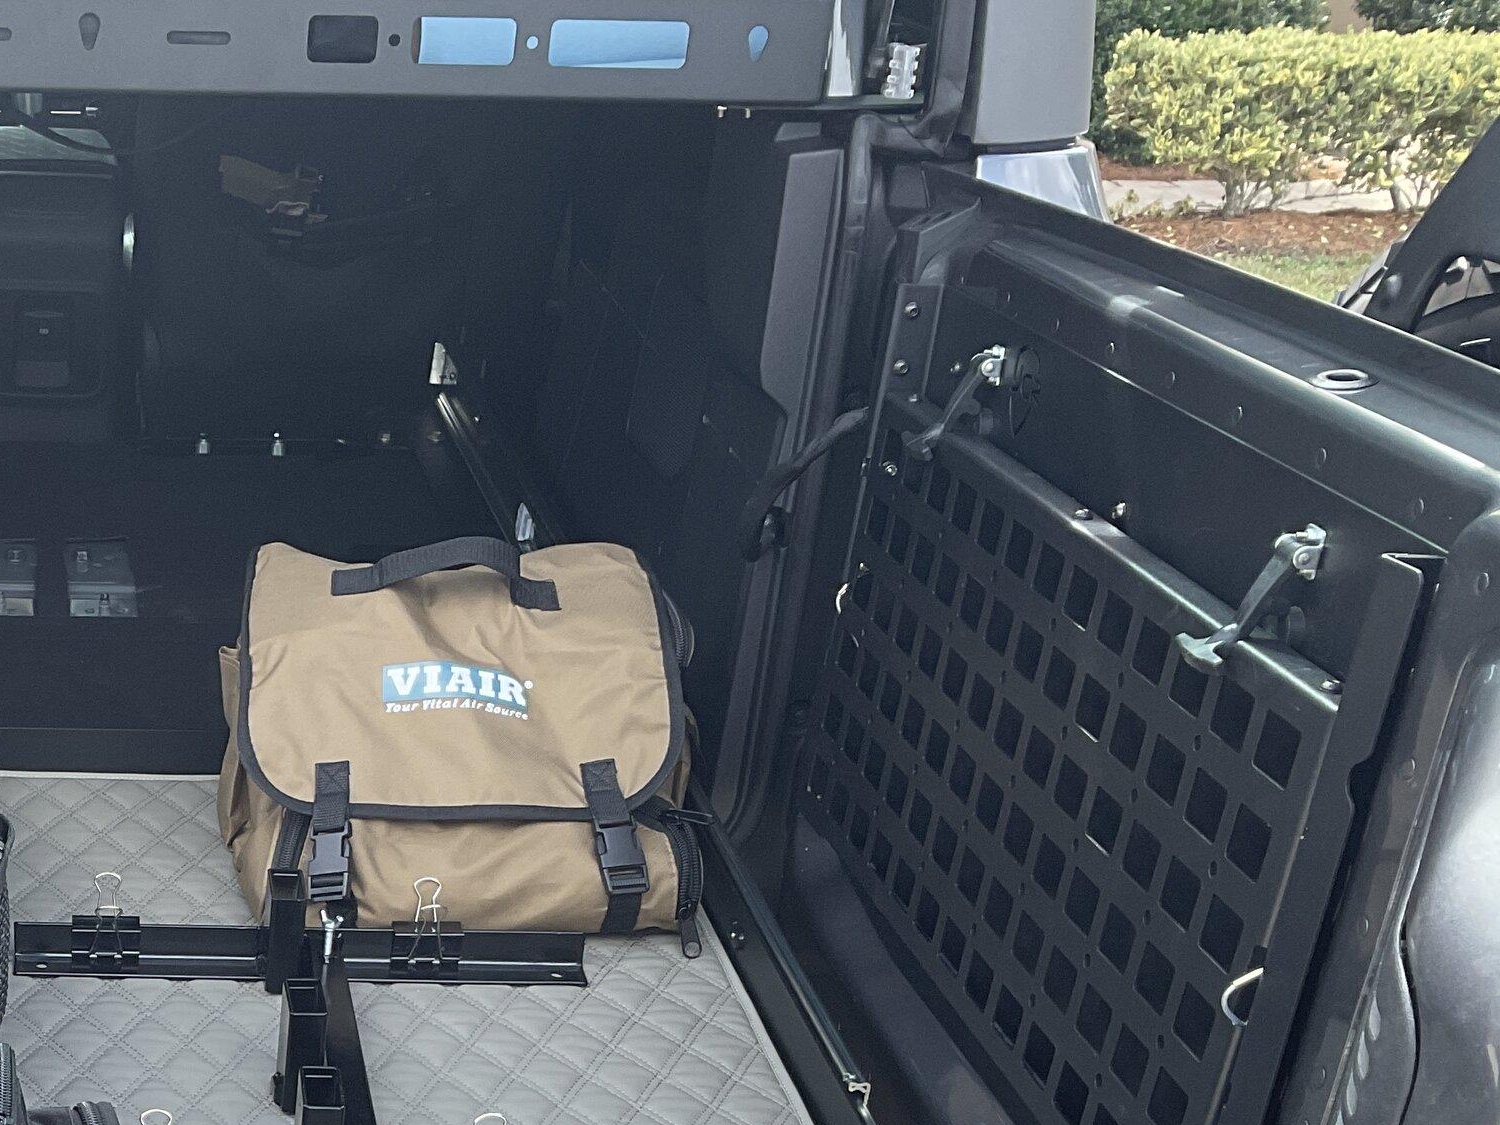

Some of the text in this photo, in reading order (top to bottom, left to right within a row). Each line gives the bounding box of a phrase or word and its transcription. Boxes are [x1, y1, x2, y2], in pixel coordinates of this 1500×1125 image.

[387, 665, 526, 707] VIAIR
[385, 698, 529, 721] Your Vital Air Source
